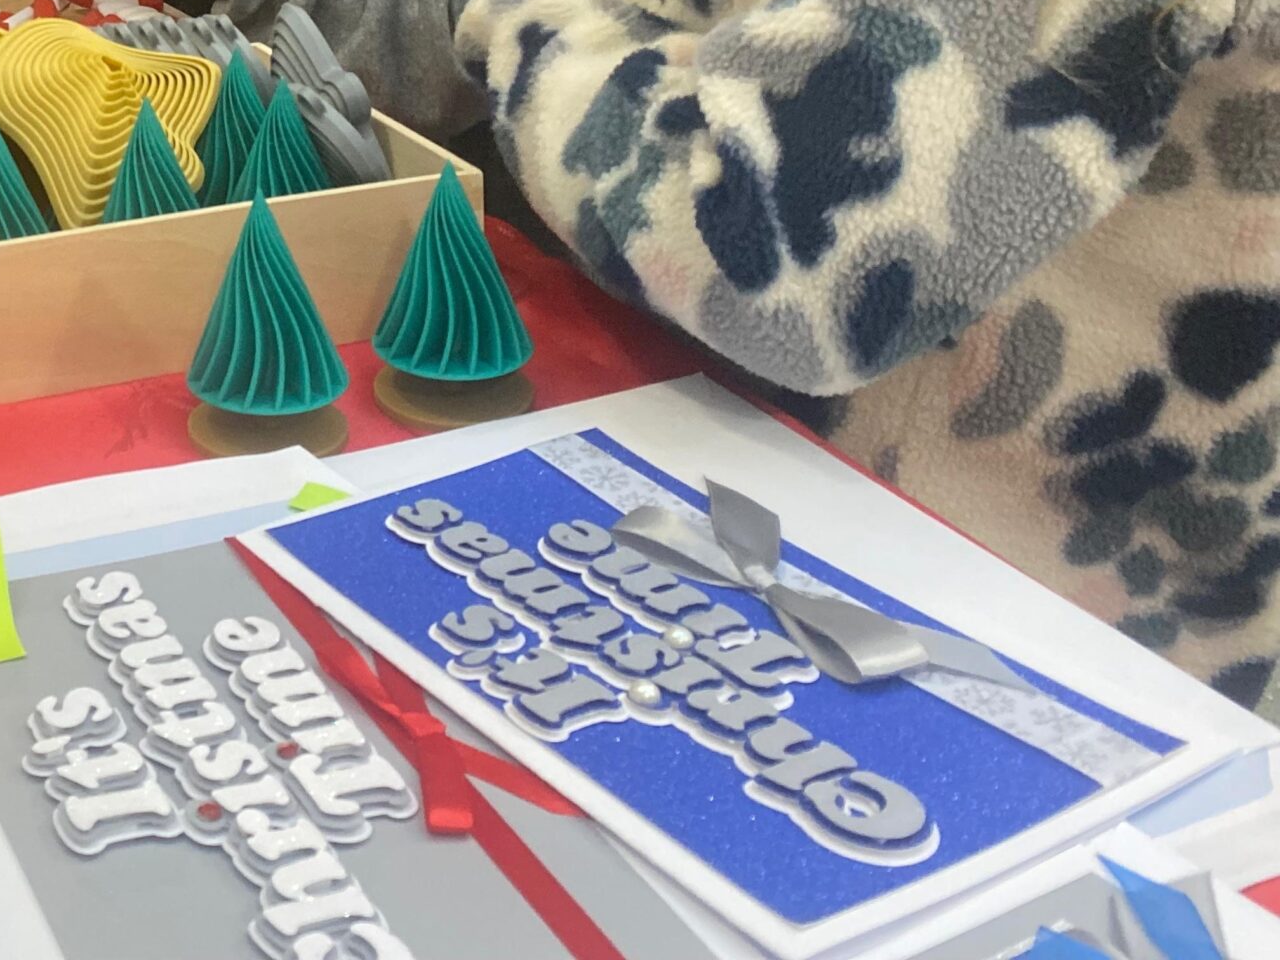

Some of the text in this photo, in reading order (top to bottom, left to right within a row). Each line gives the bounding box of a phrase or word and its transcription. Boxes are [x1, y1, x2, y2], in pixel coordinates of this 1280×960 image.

[397, 498, 927, 840] Christmas
[442, 604, 618, 724] It's
[549, 518, 806, 686] Time
[28, 687, 174, 831] It's
[213, 615, 407, 815] Time
